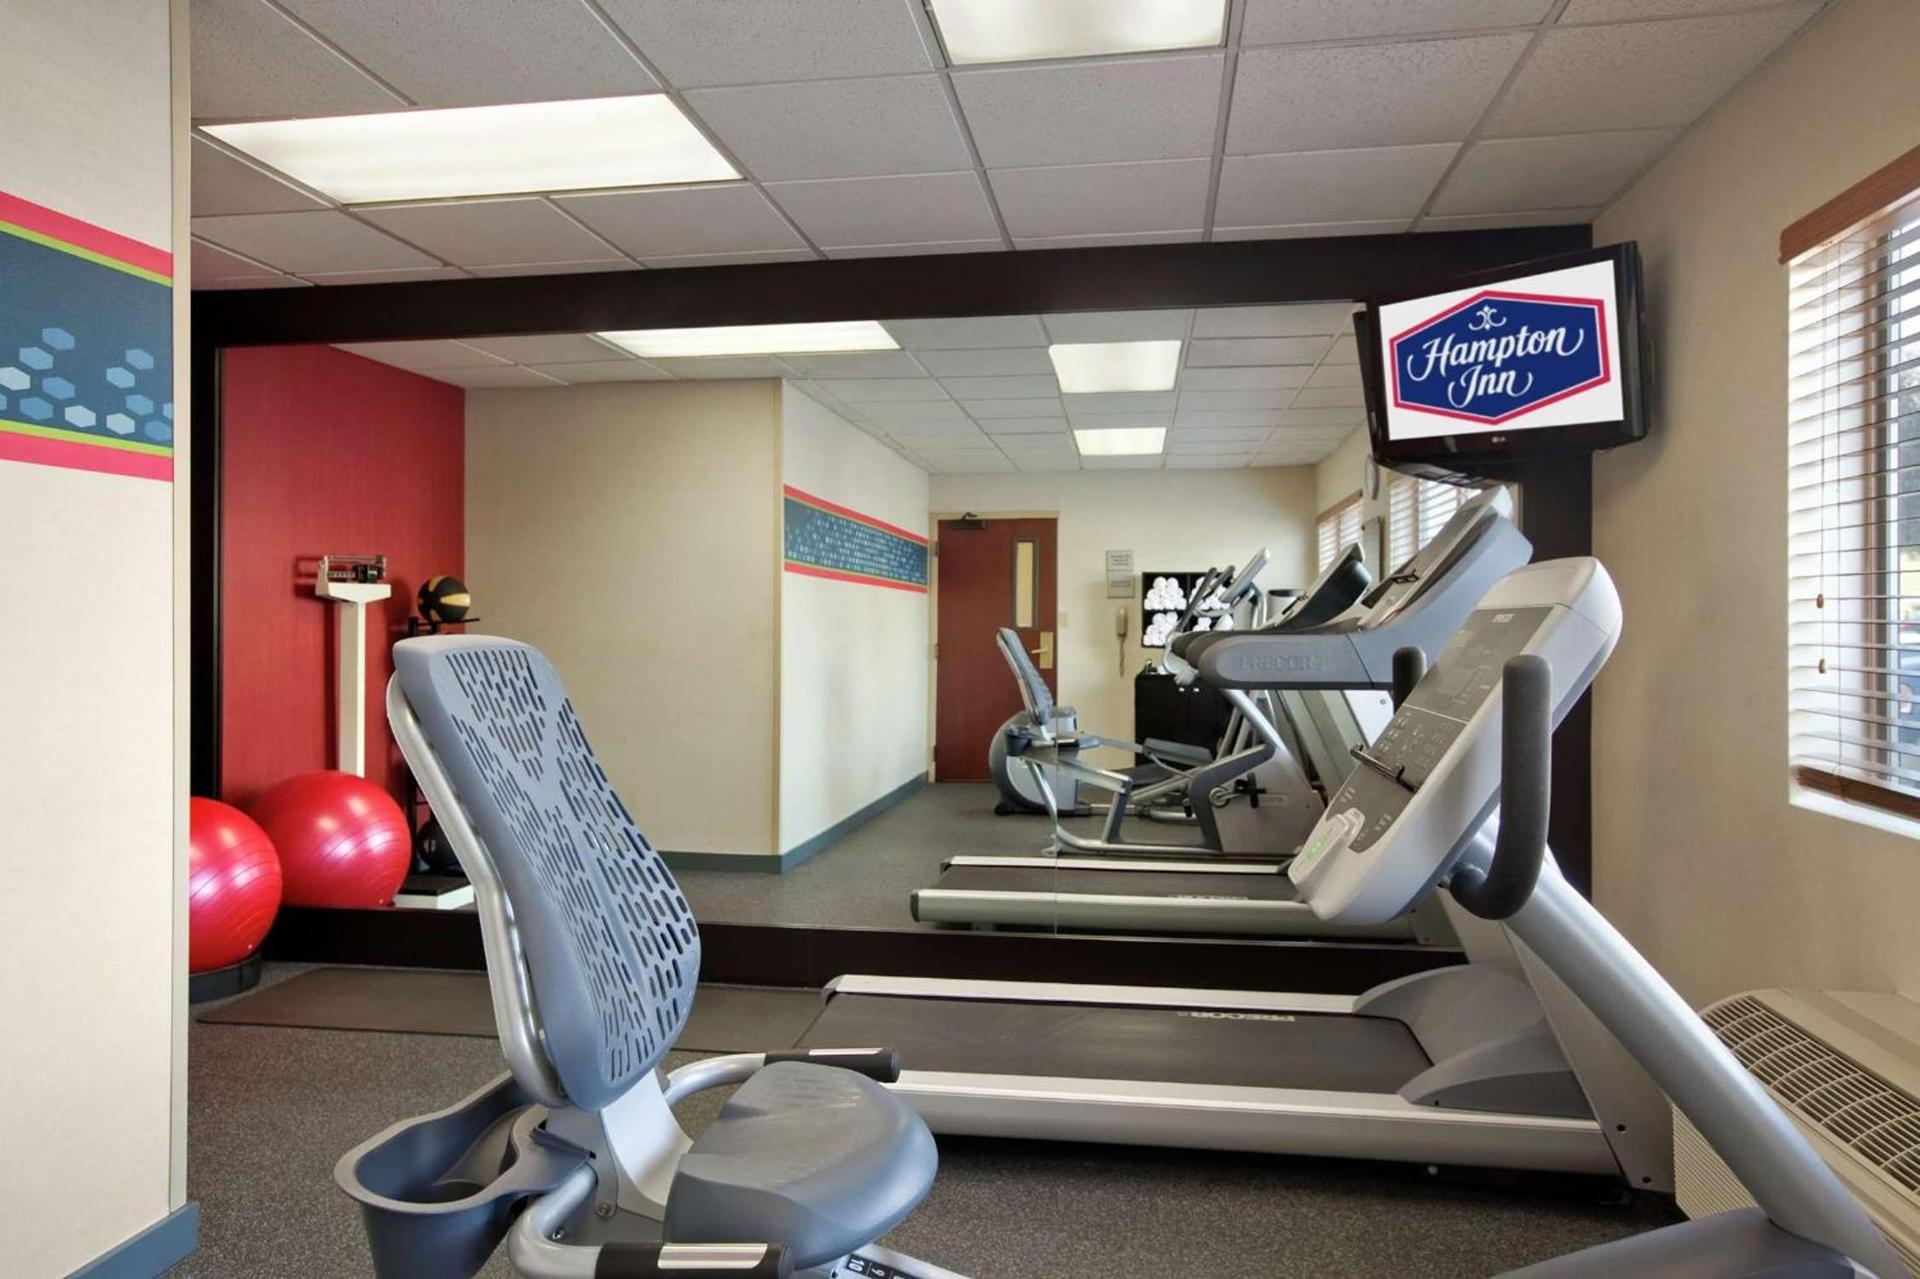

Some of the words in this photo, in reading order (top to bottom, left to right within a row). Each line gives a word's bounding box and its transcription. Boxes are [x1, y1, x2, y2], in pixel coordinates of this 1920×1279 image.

[1407, 325, 1584, 382] Hampton
[1448, 364, 1533, 408] Inn
[848, 1259, 865, 1272] 10
